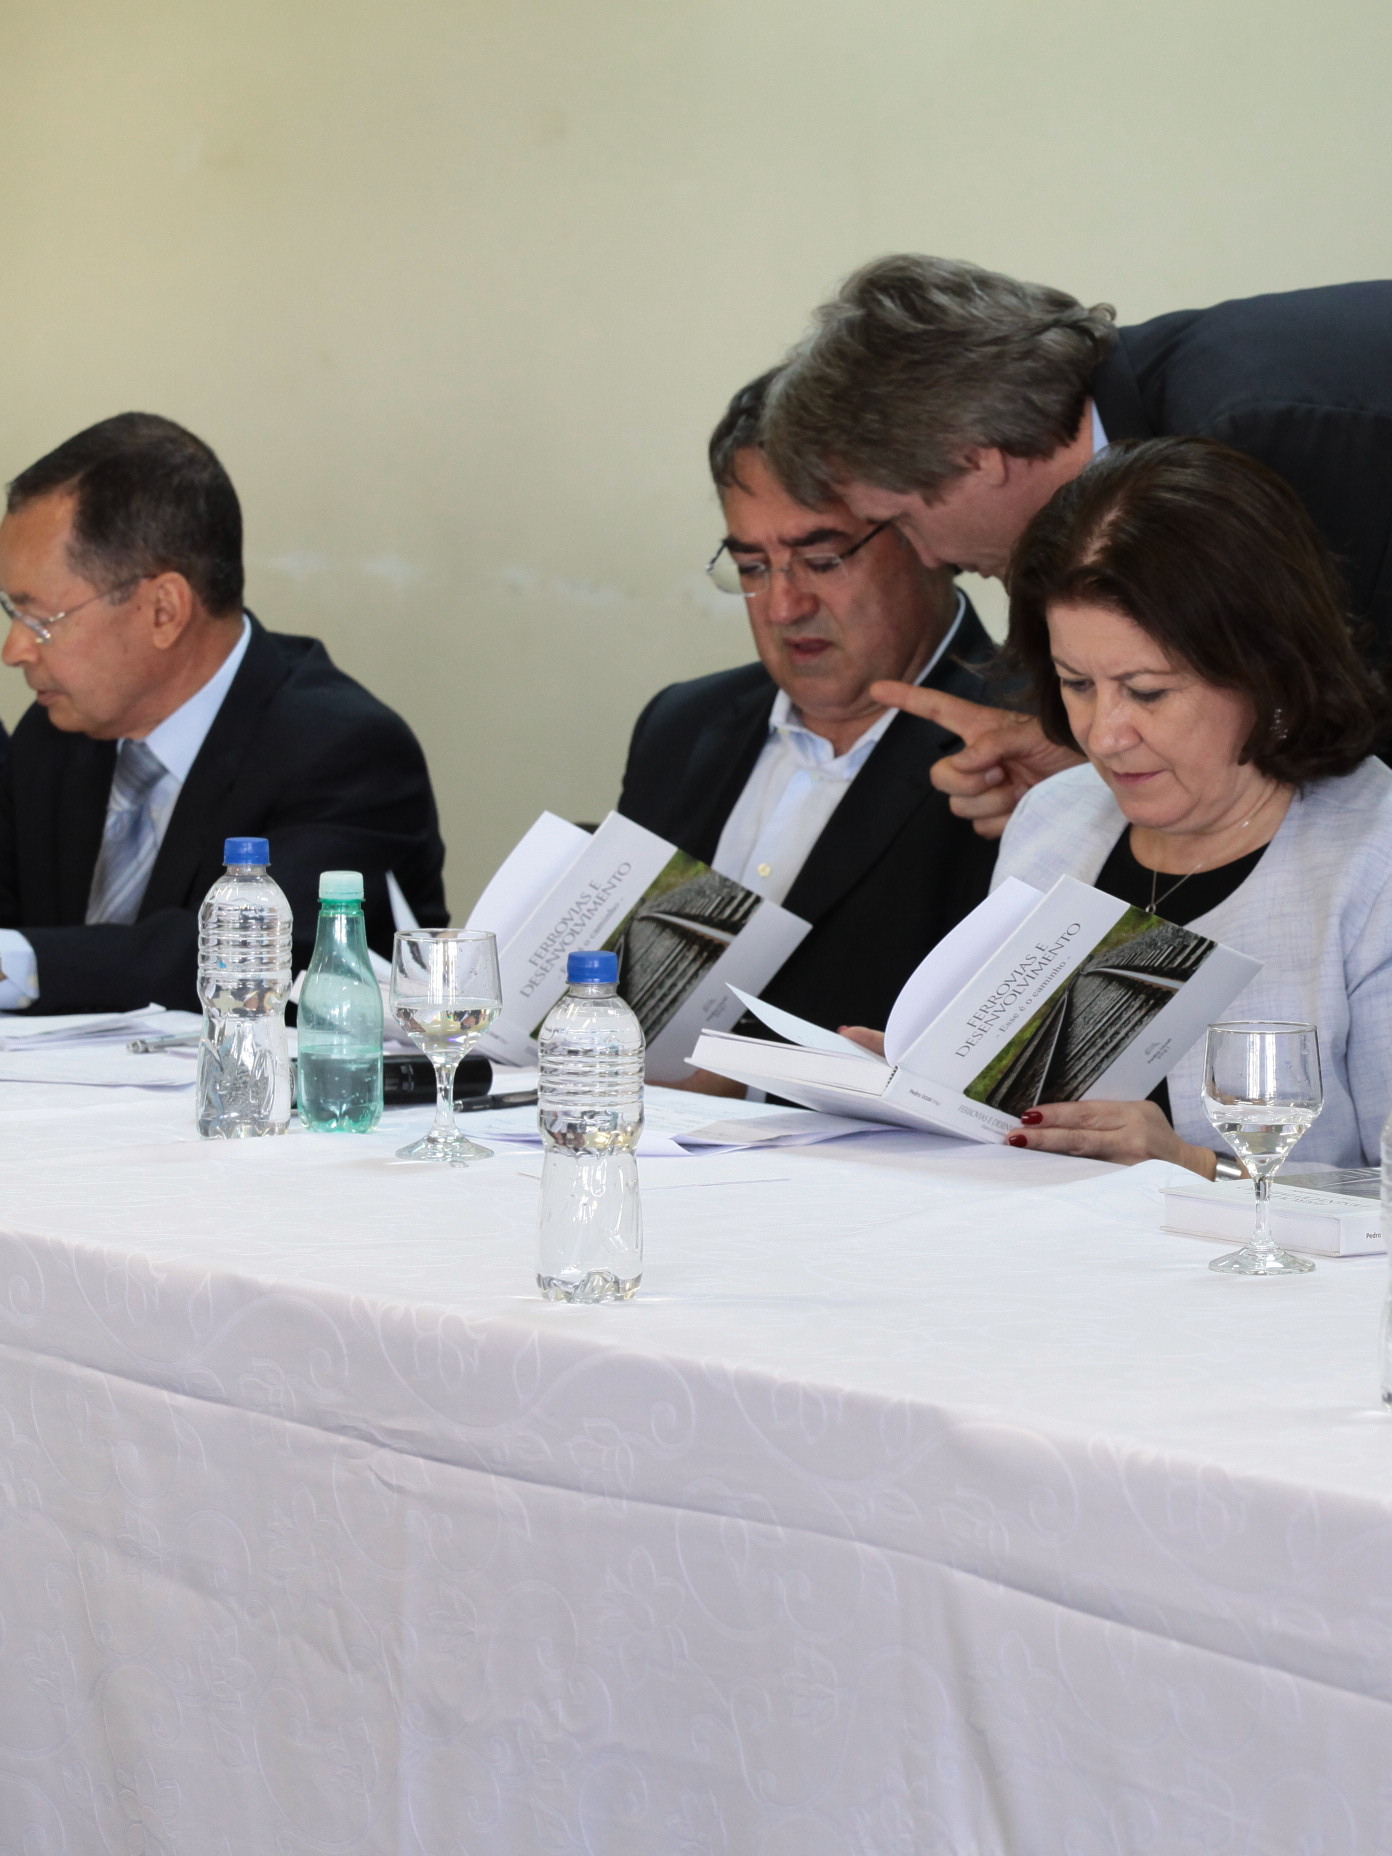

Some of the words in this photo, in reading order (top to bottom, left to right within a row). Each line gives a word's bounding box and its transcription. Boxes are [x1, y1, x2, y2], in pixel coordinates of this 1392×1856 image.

[520, 862, 632, 998] DESENVOLVIMENTO
[528, 892, 592, 967] FERROVIAS
[589, 880, 602, 891] E
[954, 922, 1081, 1058] DESENVOLVIMENTO
[966, 953, 1038, 1029] FERROVIAS
[1035, 942, 1049, 952] E
[998, 1012, 1020, 1033] Esse
[1032, 961, 1066, 998] caminho
[958, 1104, 988, 1122] FERROVIAS
